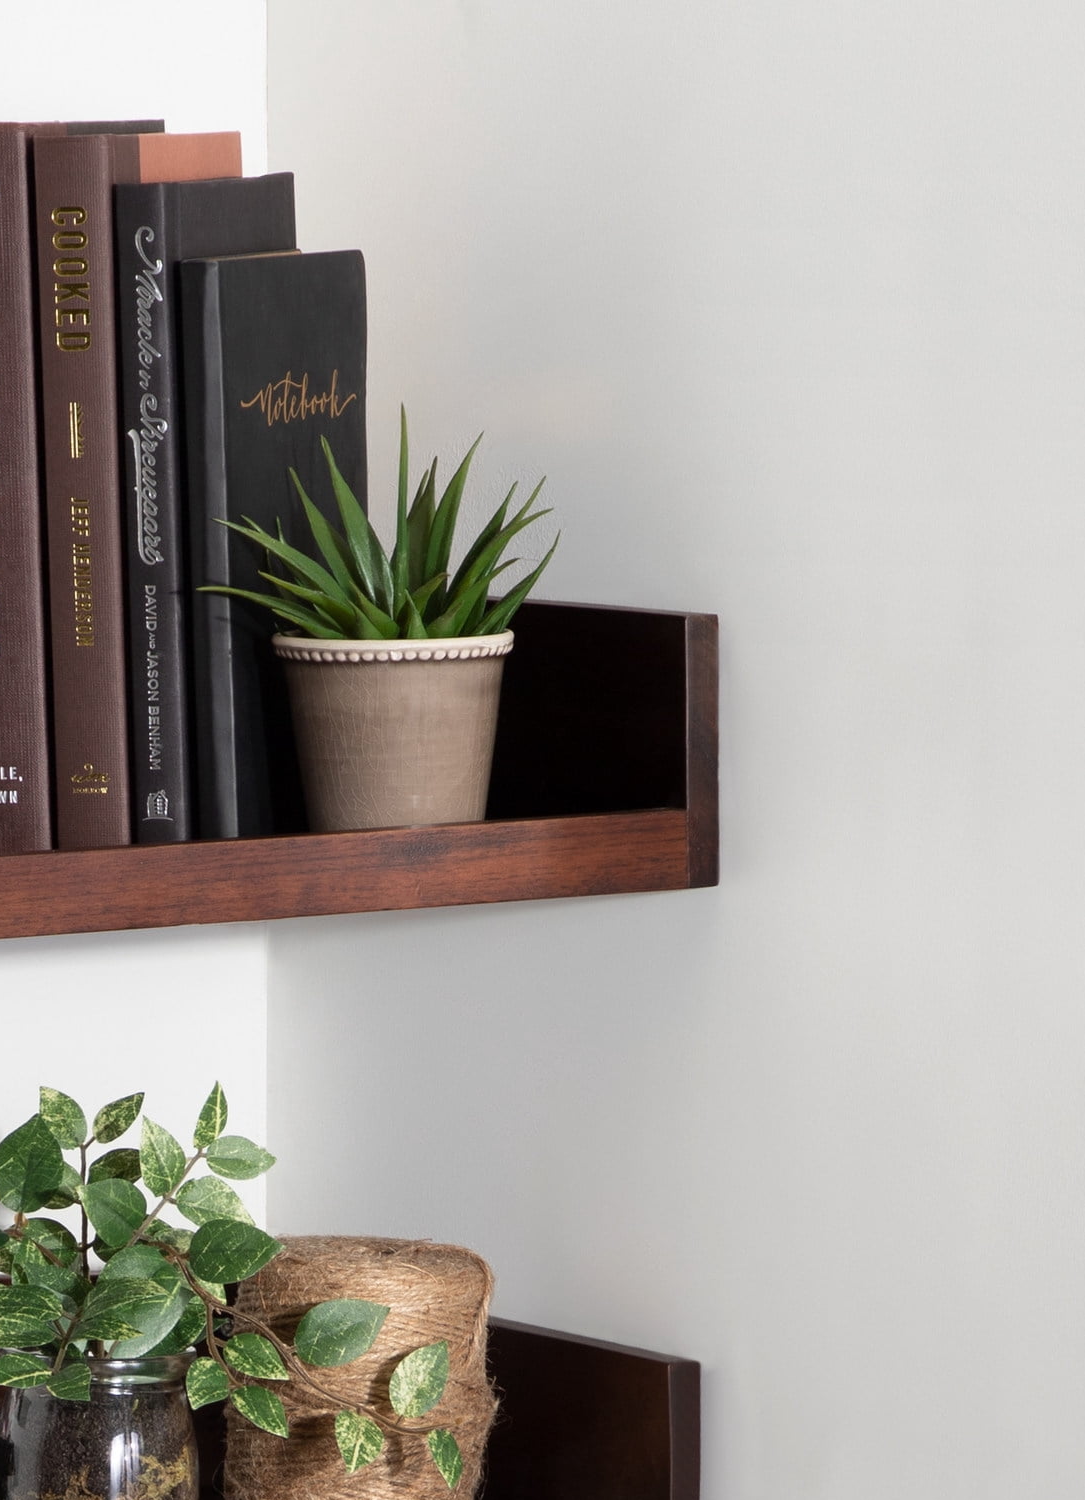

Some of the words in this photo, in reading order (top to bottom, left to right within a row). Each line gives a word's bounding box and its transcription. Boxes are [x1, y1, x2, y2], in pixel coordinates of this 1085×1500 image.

[51, 206, 92, 352] COOKED
[134, 225, 165, 365] Miracle
[240, 369, 357, 427] Notebook
[127, 392, 168, 566] Shreveport
[71, 497, 90, 537] JEFF
[72, 543, 95, 648] HENDERSON
[144, 584, 158, 631] DAVID
[146, 650, 160, 701] JASON
[147, 706, 161, 771] BENHAM
